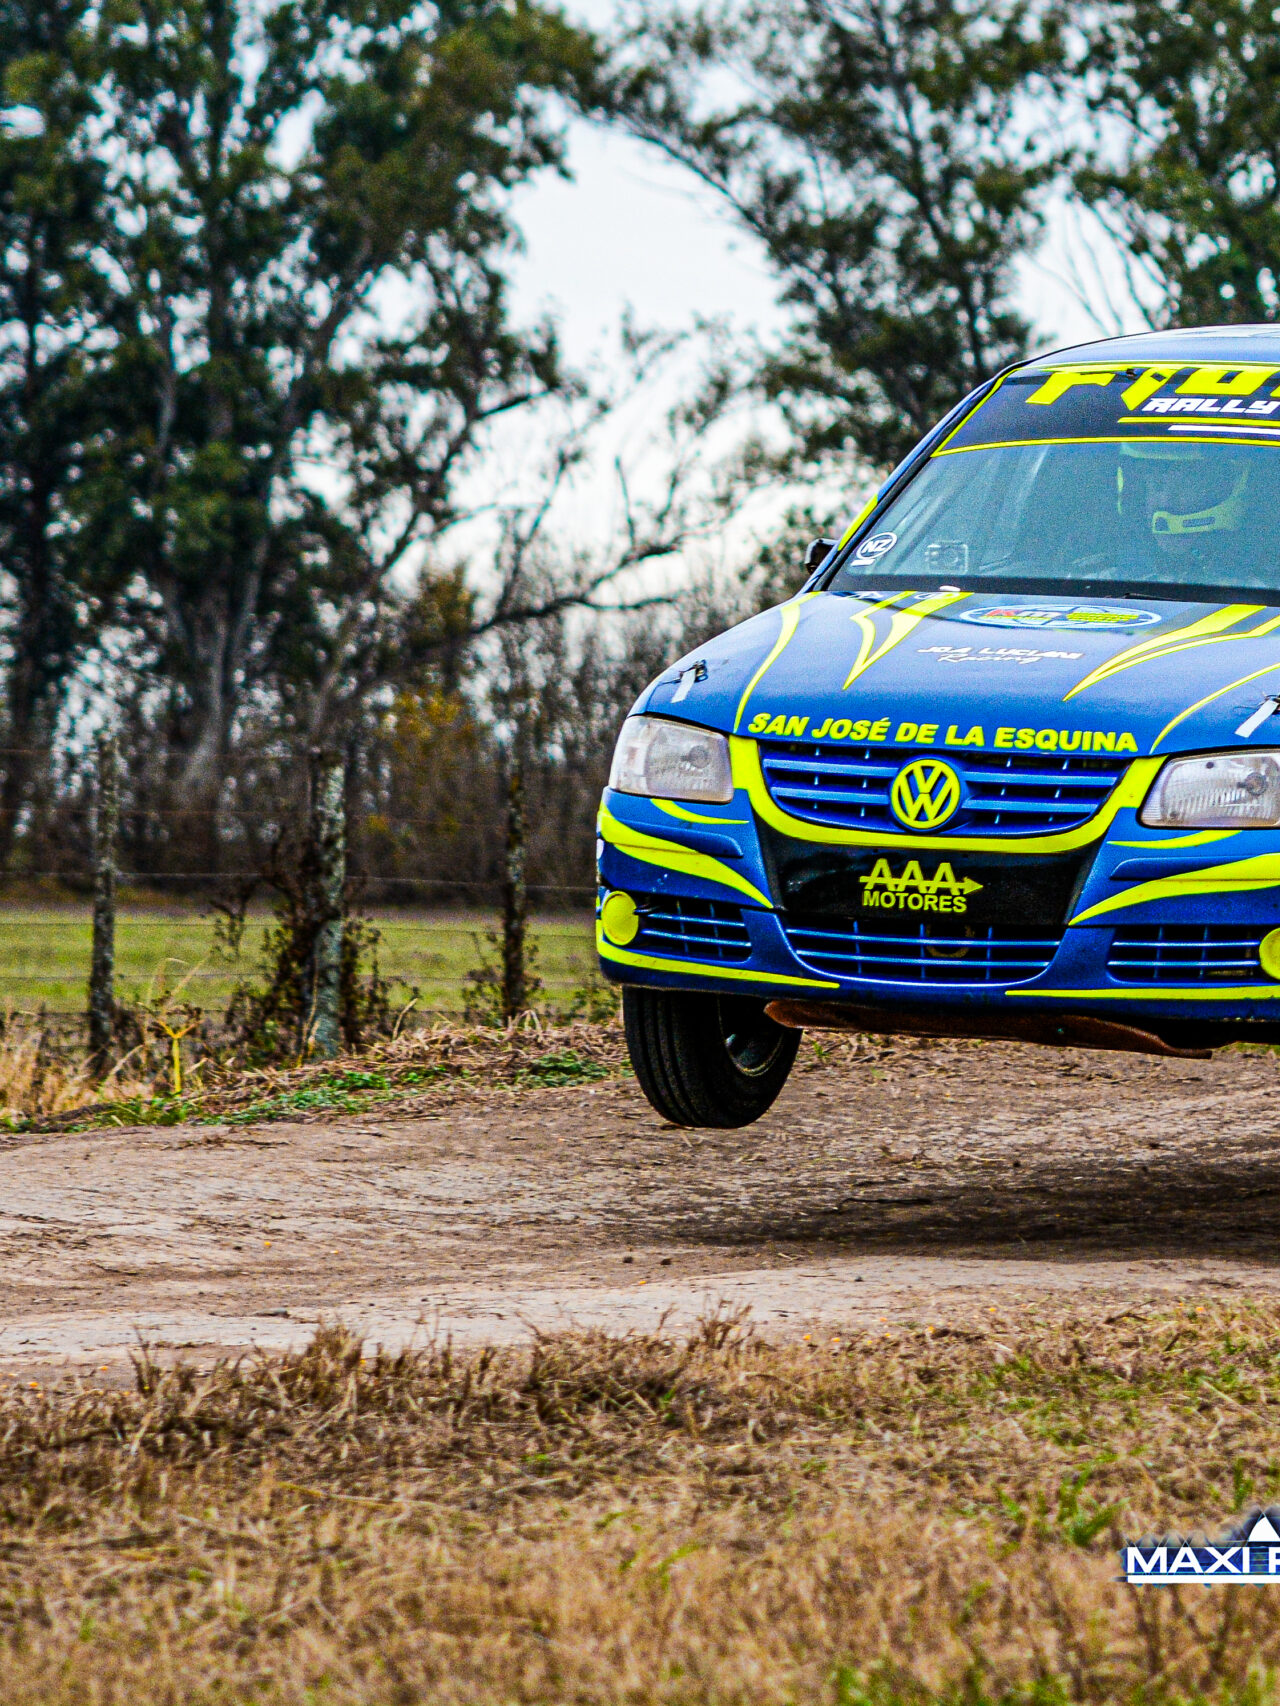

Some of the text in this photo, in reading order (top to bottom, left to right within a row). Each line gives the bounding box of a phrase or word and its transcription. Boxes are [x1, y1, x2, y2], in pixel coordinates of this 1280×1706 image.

[937, 653, 1045, 665] Racing
[748, 712, 1138, 752] SAN JOSÉ DE LA ESQUINA
[864, 858, 961, 895] AAA
[863, 890, 967, 913] MOTORES
